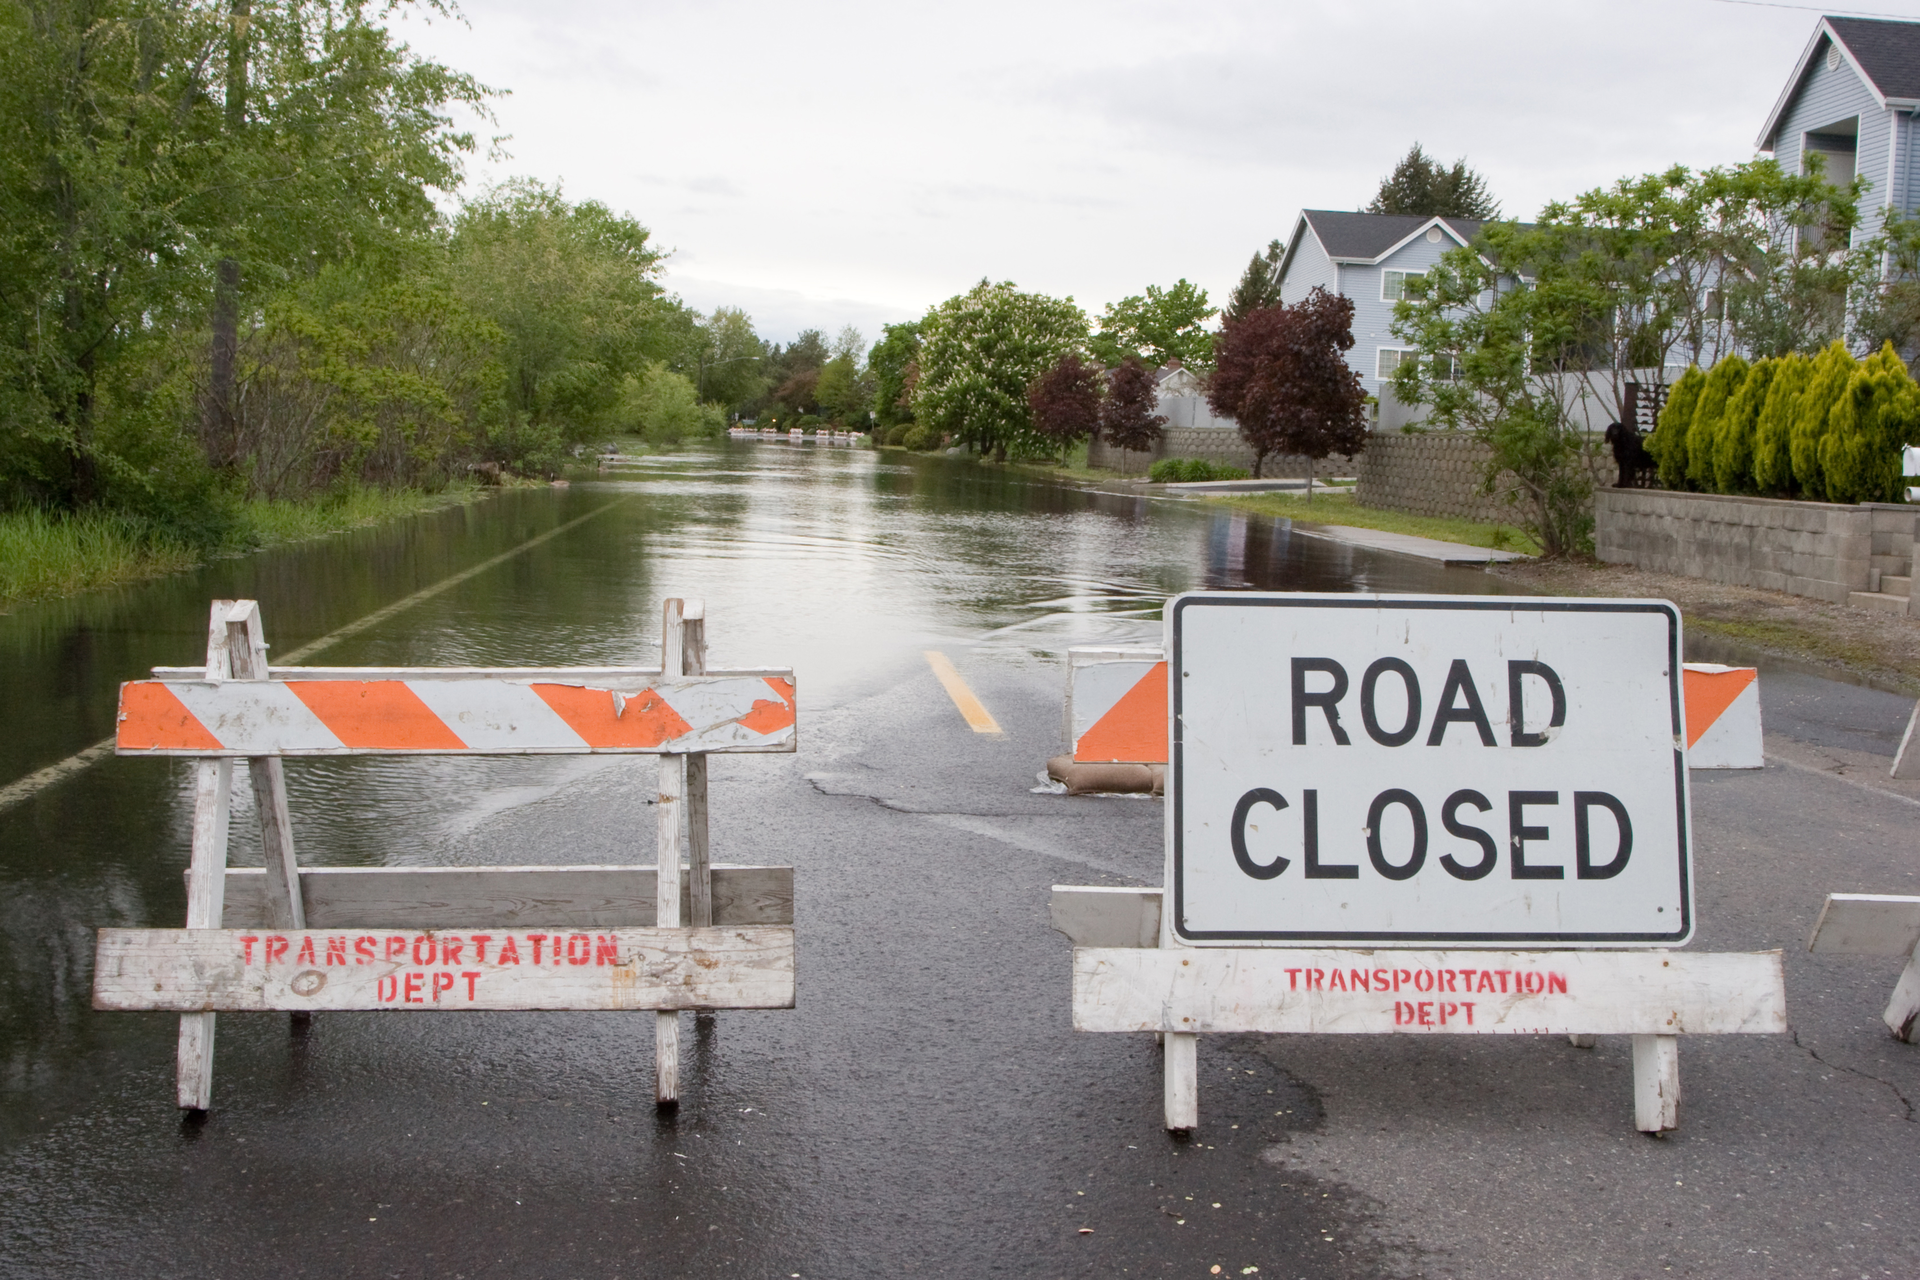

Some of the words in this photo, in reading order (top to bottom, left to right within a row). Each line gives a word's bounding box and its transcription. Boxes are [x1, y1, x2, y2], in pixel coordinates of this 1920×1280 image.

[1292, 657, 1566, 747] ROAD
[1231, 788, 1633, 880] CLOSED
[240, 934, 619, 966] TRANSPORTATION
[378, 971, 482, 1003] DEPT
[1284, 968, 1568, 994] TRANSPORTATION
[1394, 1001, 1477, 1026] DEPT
